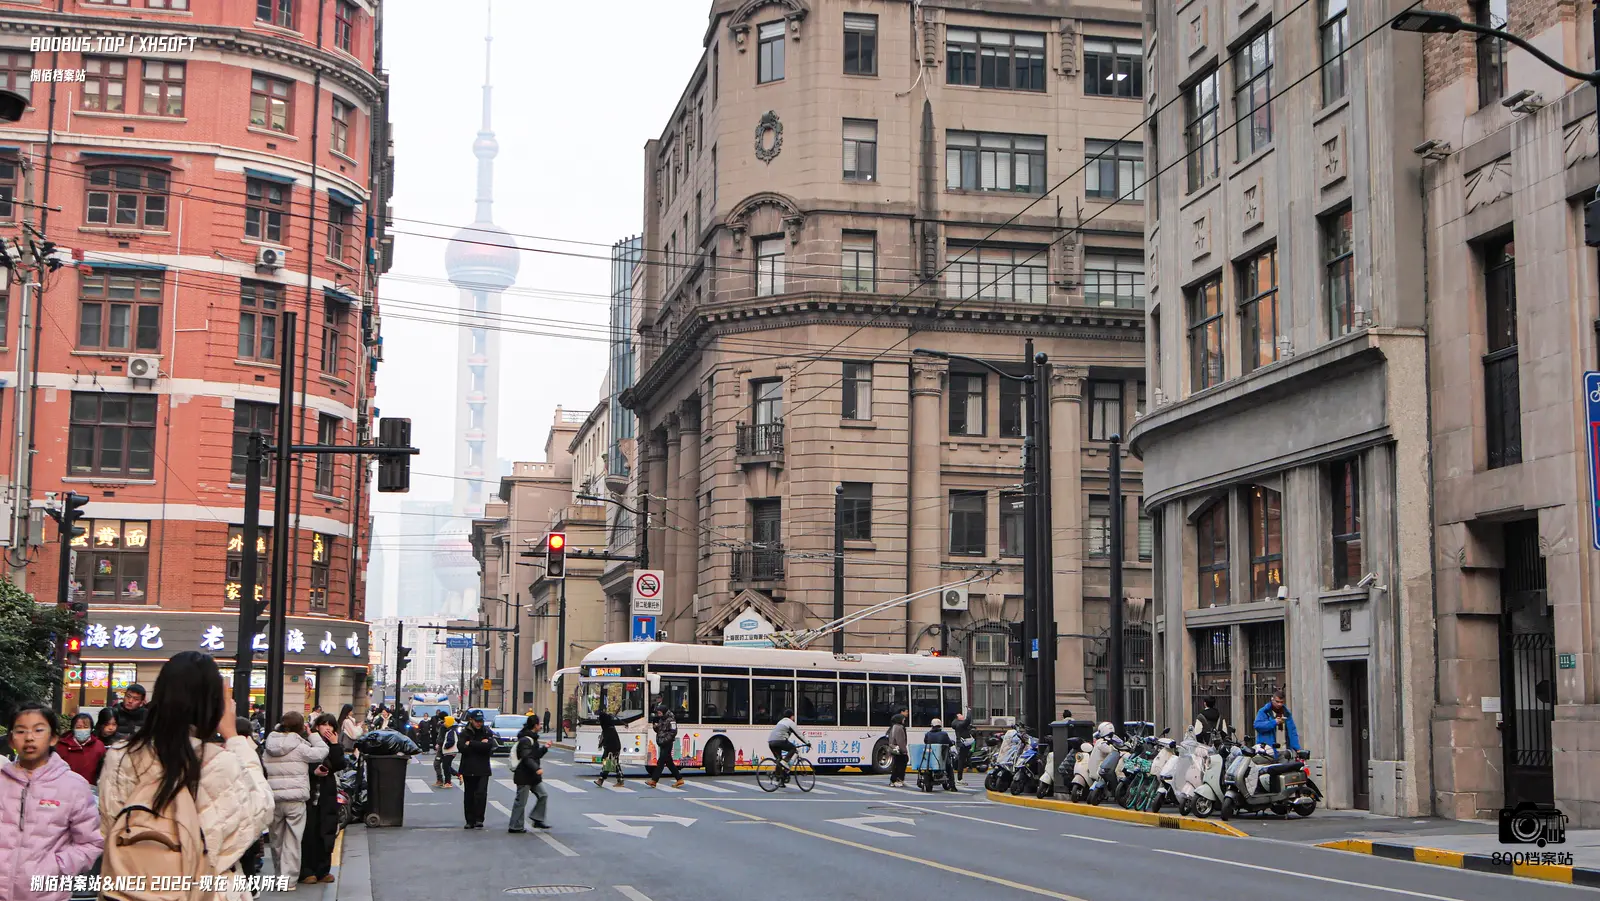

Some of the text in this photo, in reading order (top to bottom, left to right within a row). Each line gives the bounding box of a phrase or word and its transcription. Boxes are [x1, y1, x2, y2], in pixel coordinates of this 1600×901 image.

[65, 623, 164, 650] 海汤包
[725, 633, 769, 641] 上海医药工业有限公
[817, 740, 861, 754] 南美之约
